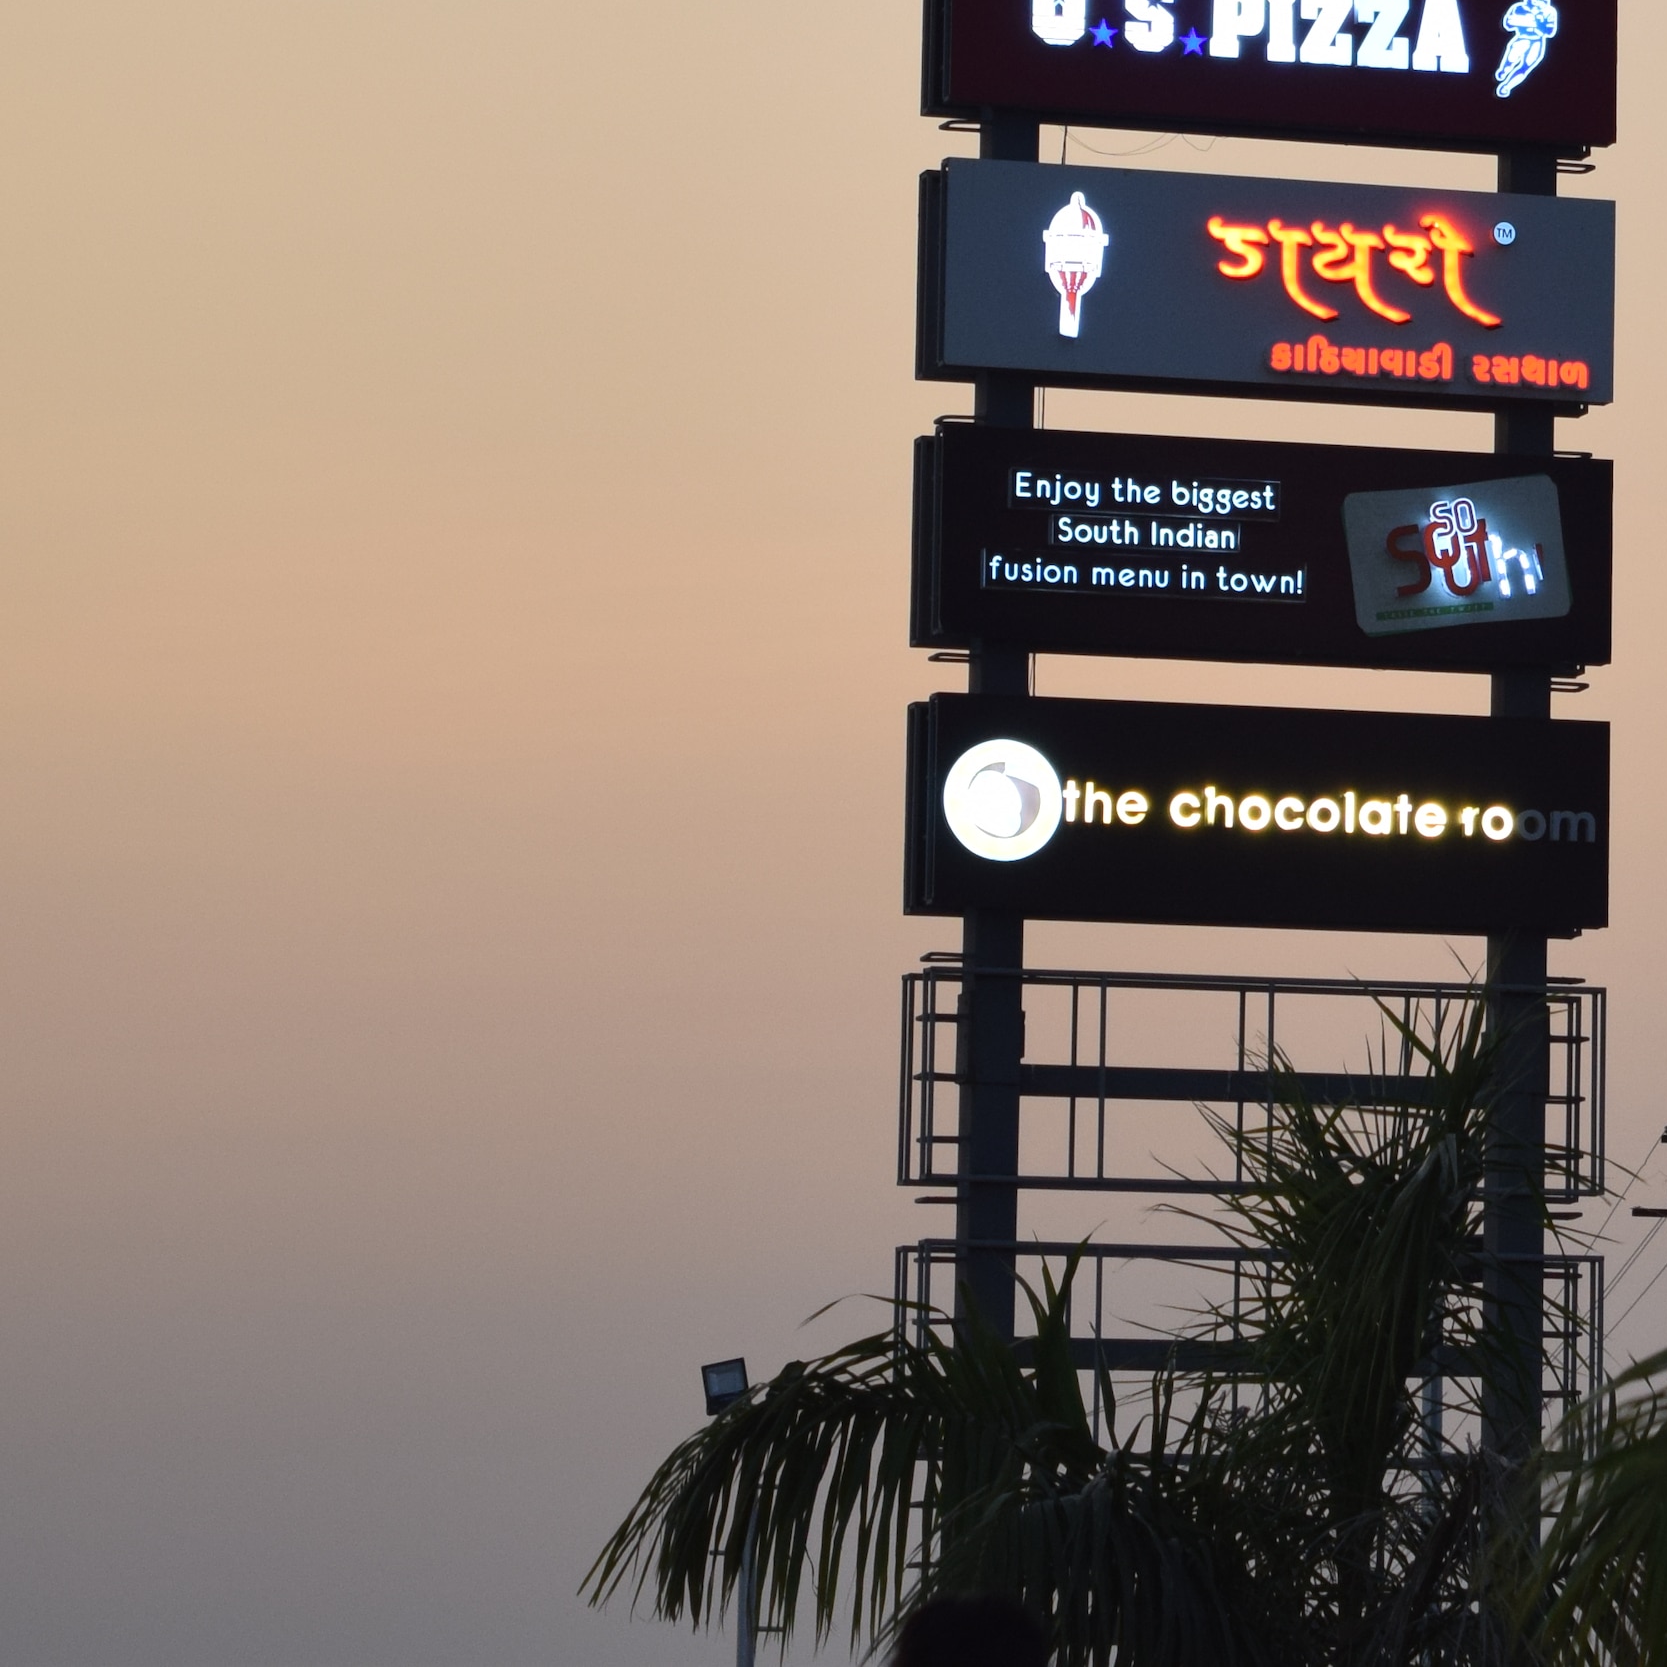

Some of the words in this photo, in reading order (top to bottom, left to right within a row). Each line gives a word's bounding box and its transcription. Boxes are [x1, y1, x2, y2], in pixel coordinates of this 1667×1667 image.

[1015, 471, 1100, 508] Enjoy
[1110, 476, 1161, 505] the
[1171, 479, 1276, 515] biggest
[1057, 516, 1140, 546] South
[1150, 520, 1236, 550] Indian
[988, 554, 1078, 584] fusion
[1091, 565, 1170, 589] menu
[1181, 563, 1206, 590] in
[1215, 564, 1304, 595] town!
[1063, 780, 1149, 825] the
[1169, 786, 1448, 838] chocolate
[1459, 804, 1596, 843] room
